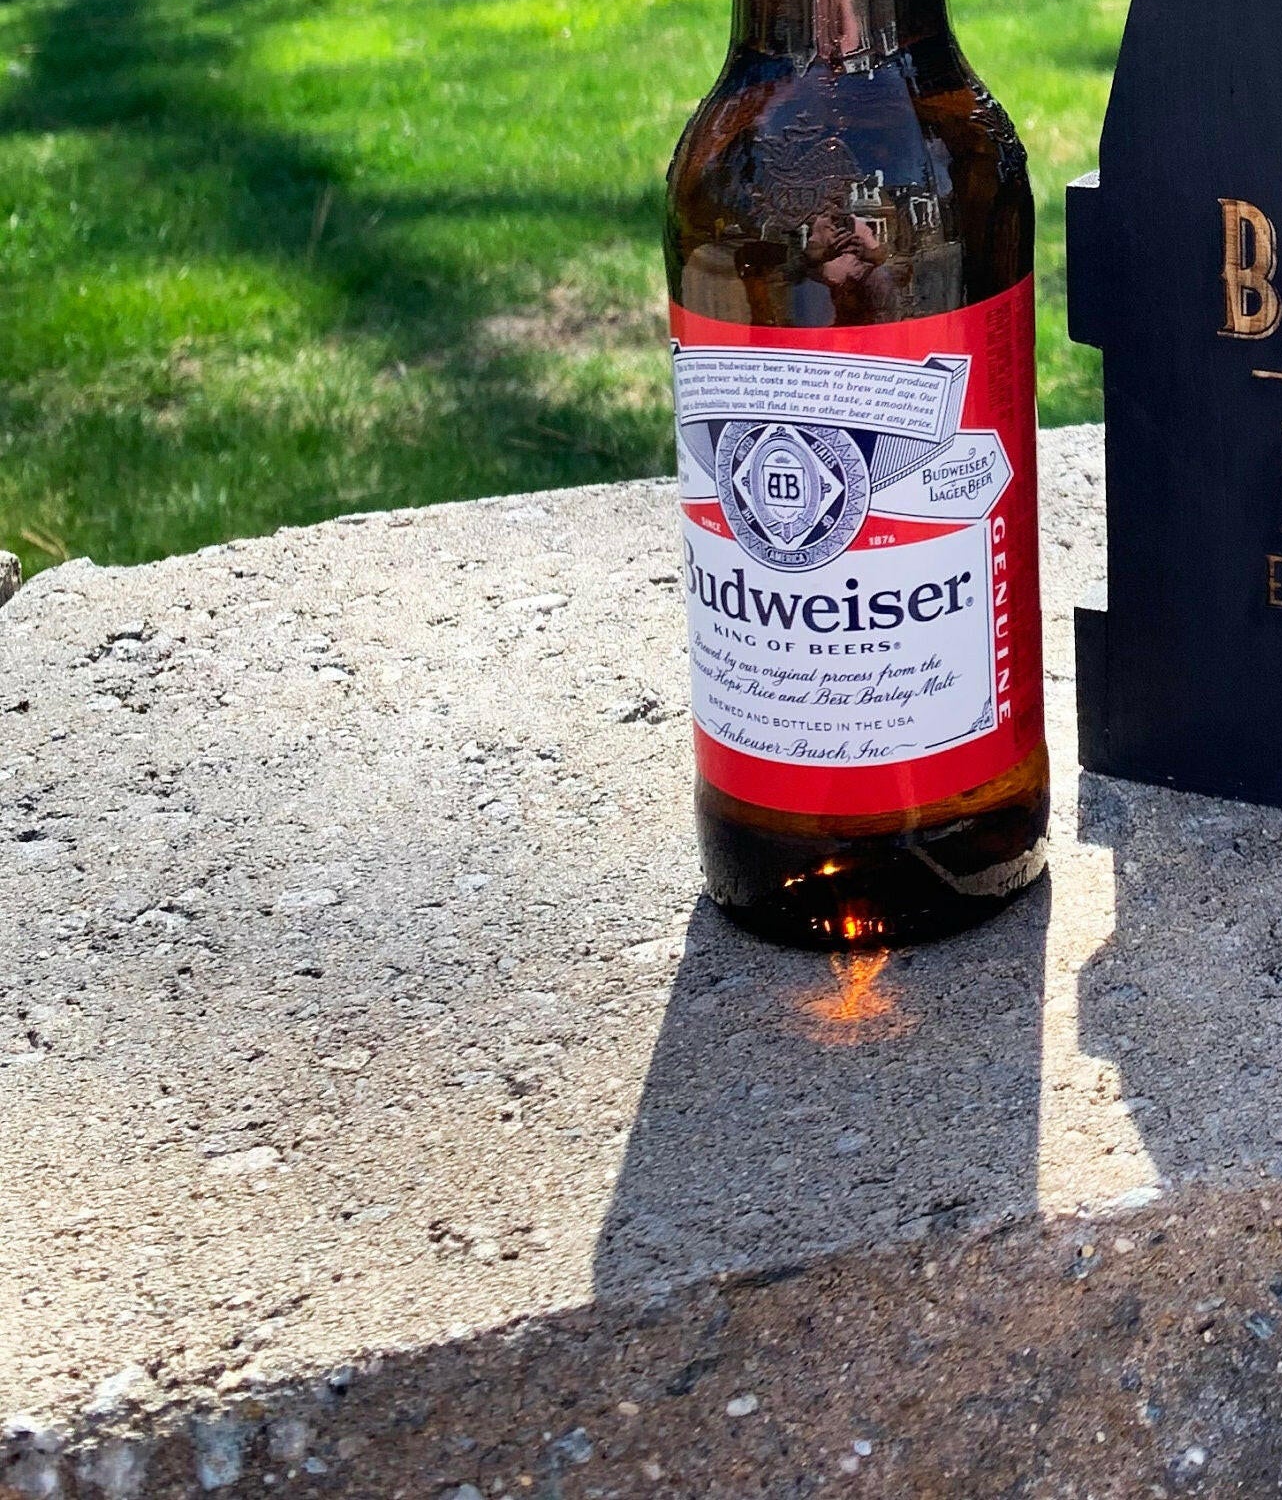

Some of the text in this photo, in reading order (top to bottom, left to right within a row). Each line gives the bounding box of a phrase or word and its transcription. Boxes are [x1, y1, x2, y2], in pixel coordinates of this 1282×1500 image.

[718, 362, 760, 372] Budweiser
[787, 364, 802, 374] We
[804, 365, 831, 376] know
[834, 368, 848, 378] of
[848, 371, 861, 379] no
[862, 371, 895, 383] brand
[895, 377, 940, 390] produced
[733, 375, 757, 384] which
[760, 377, 784, 385] costs
[801, 379, 829, 388] much
[833, 381, 844, 390] to
[846, 382, 873, 392] brew
[875, 387, 896, 396] and
[920, 392, 938, 403] Our
[701, 386, 740, 396] Beechwood
[743, 387, 769, 398] Aging
[773, 390, 820, 400] produces
[833, 394, 863, 406] taste,
[875, 400, 935, 415] smoothness
[749, 400, 765, 409] will
[767, 401, 787, 411] find
[818, 406, 847, 416] other
[848, 408, 872, 419] beer
[873, 413, 885, 421] at
[886, 415, 906, 426] any
[811, 441, 838, 470] STATES
[922, 456, 989, 485] BUDWEISER
[767, 472, 800, 500] AB
[930, 471, 994, 502] LAGER BEER
[701, 516, 722, 533] SINCE
[868, 534, 897, 547] 1876
[992, 516, 1011, 725] GENUINE
[714, 622, 757, 647] KING
[767, 639, 796, 652] OF
[723, 651, 737, 672] by
[739, 661, 760, 674] our
[762, 668, 819, 687] original
[819, 671, 873, 688] process
[876, 662, 917, 687] from
[920, 653, 942, 673] the
[742, 678, 776, 700] Rice
[778, 690, 810, 705] and
[810, 687, 854, 705] Best
[855, 686, 914, 708] Barley
[914, 669, 963, 697] Malt
[708, 694, 916, 732] BREWED AND BOTTLED IN THE USA
